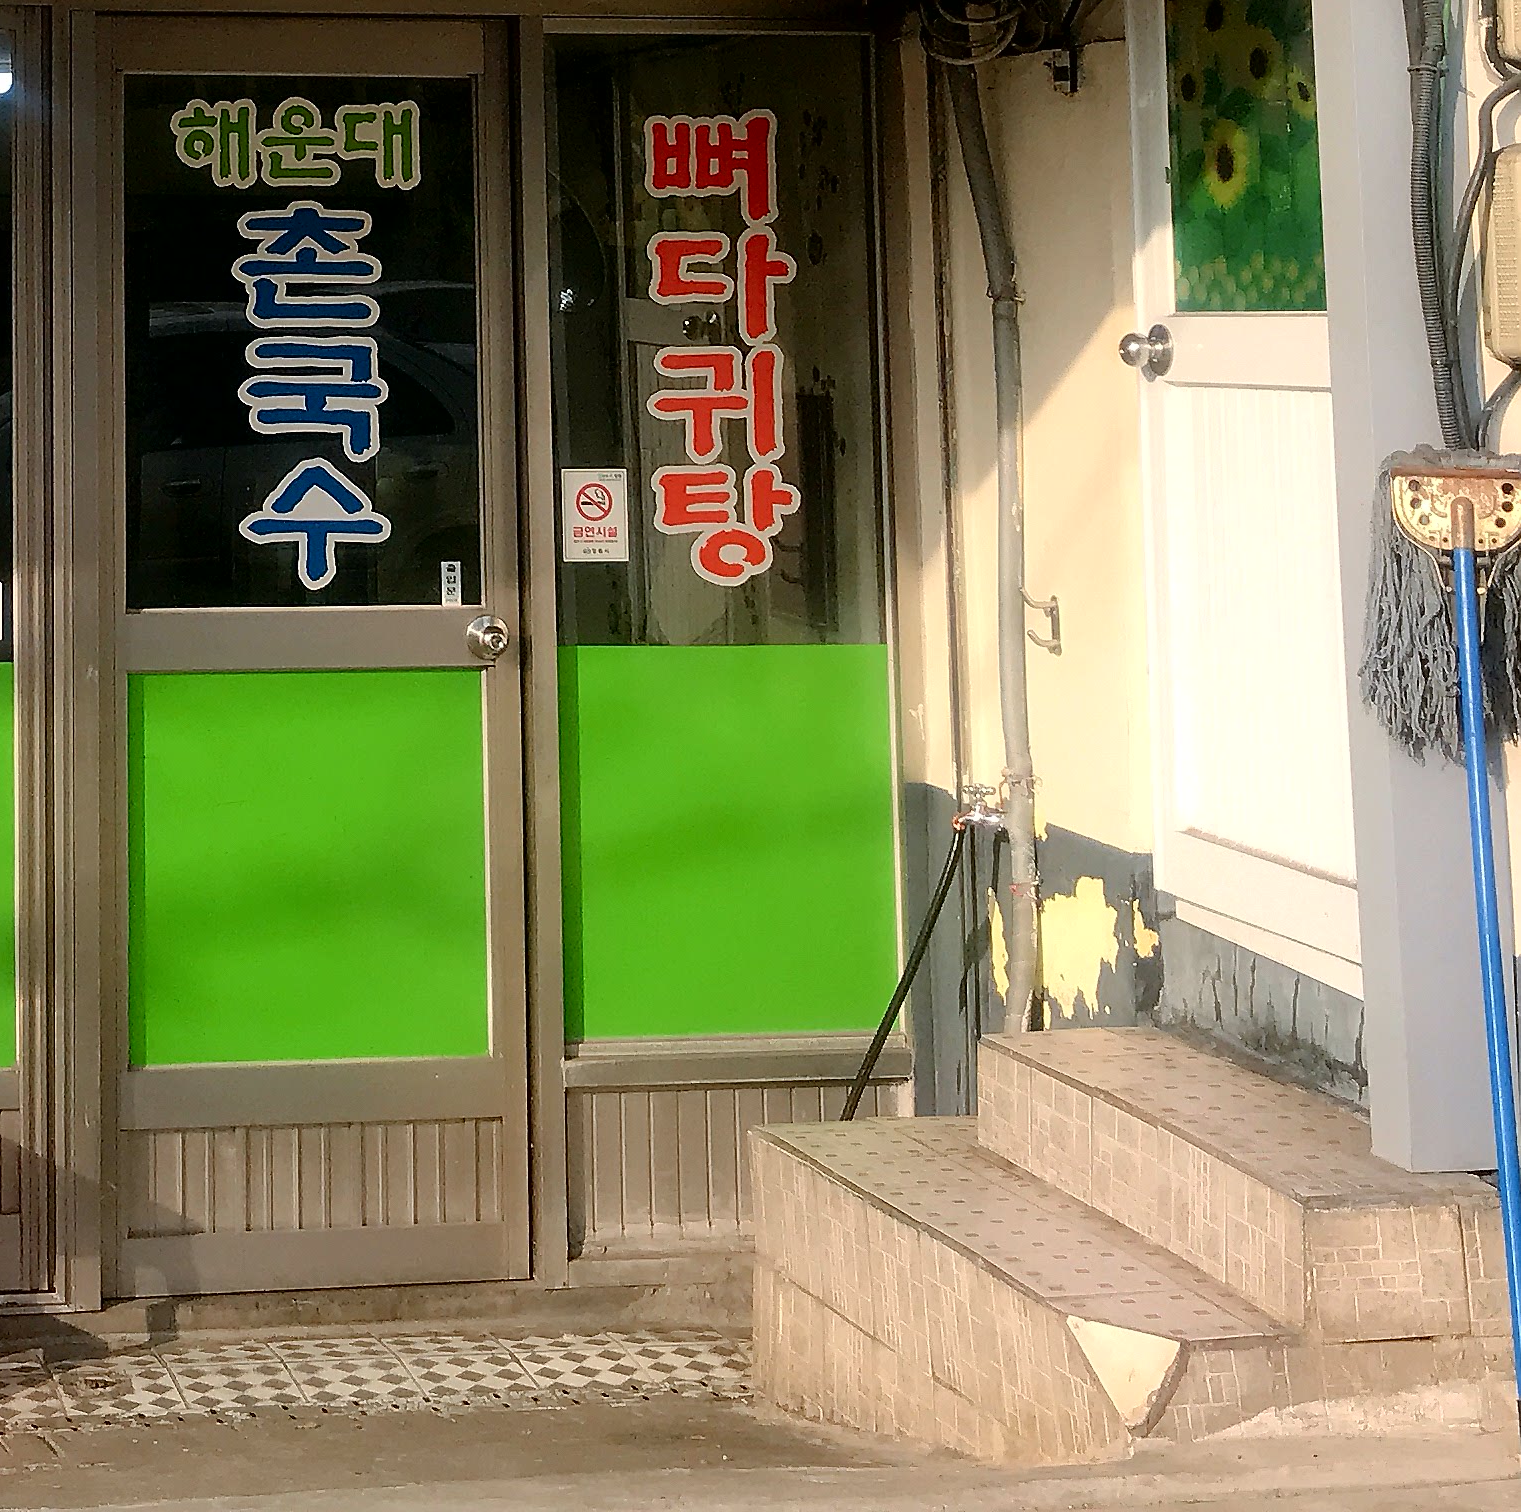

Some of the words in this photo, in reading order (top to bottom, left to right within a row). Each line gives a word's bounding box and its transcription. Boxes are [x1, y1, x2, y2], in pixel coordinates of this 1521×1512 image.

[170, 97, 421, 189] 해운대
[231, 200, 391, 590] 촌국수
[644, 108, 799, 586] 뼈다귀탕
[573, 526, 617, 538] 금연시설
